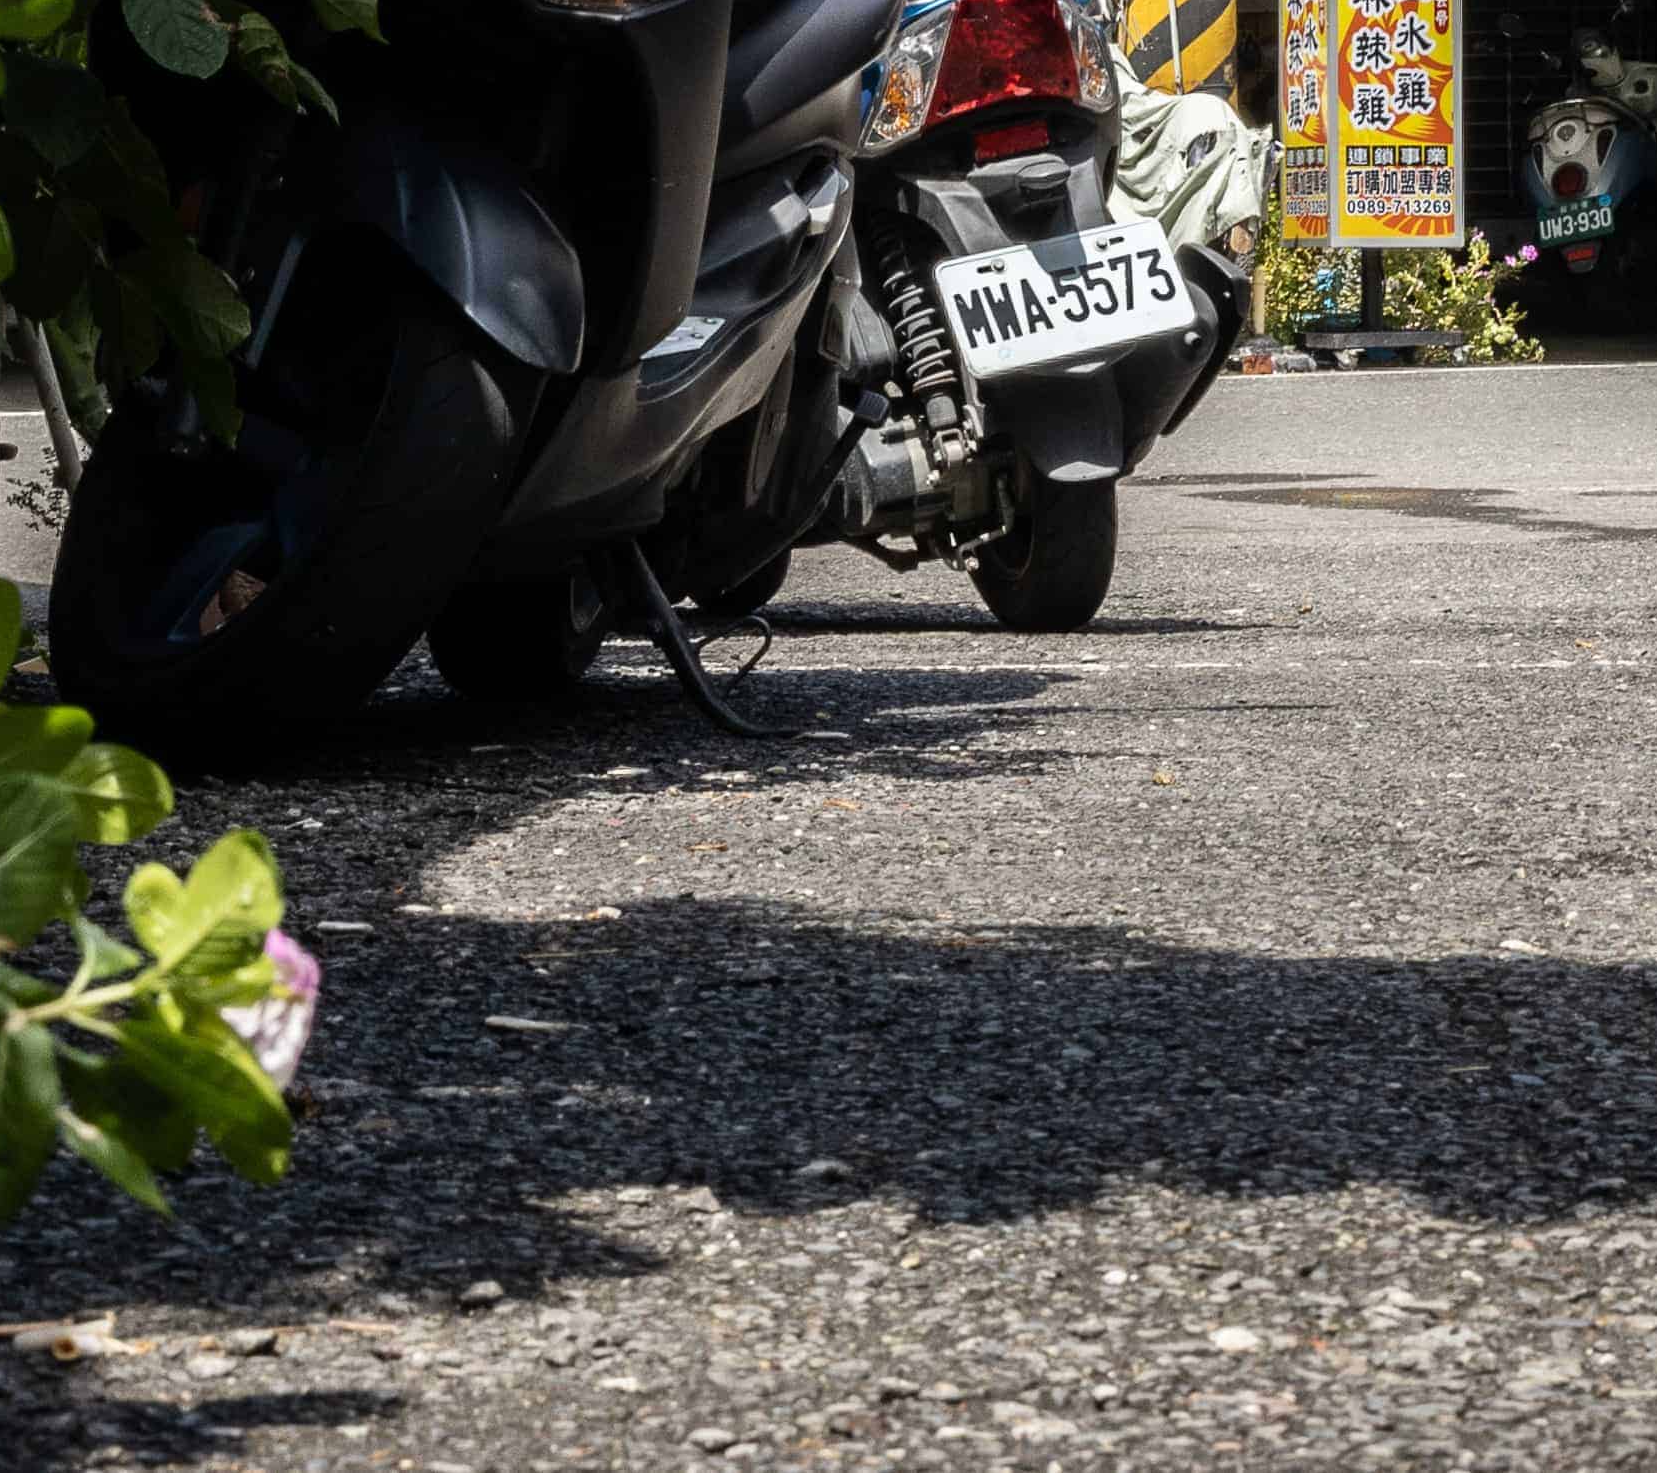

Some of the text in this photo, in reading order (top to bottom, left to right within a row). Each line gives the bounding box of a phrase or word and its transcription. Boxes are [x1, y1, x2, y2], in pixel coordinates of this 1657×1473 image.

[1346, 146, 1448, 167] 連鎖事業
[1346, 169, 1452, 196] 訂購加盟專線
[1346, 199, 1451, 215] 0989-713269
